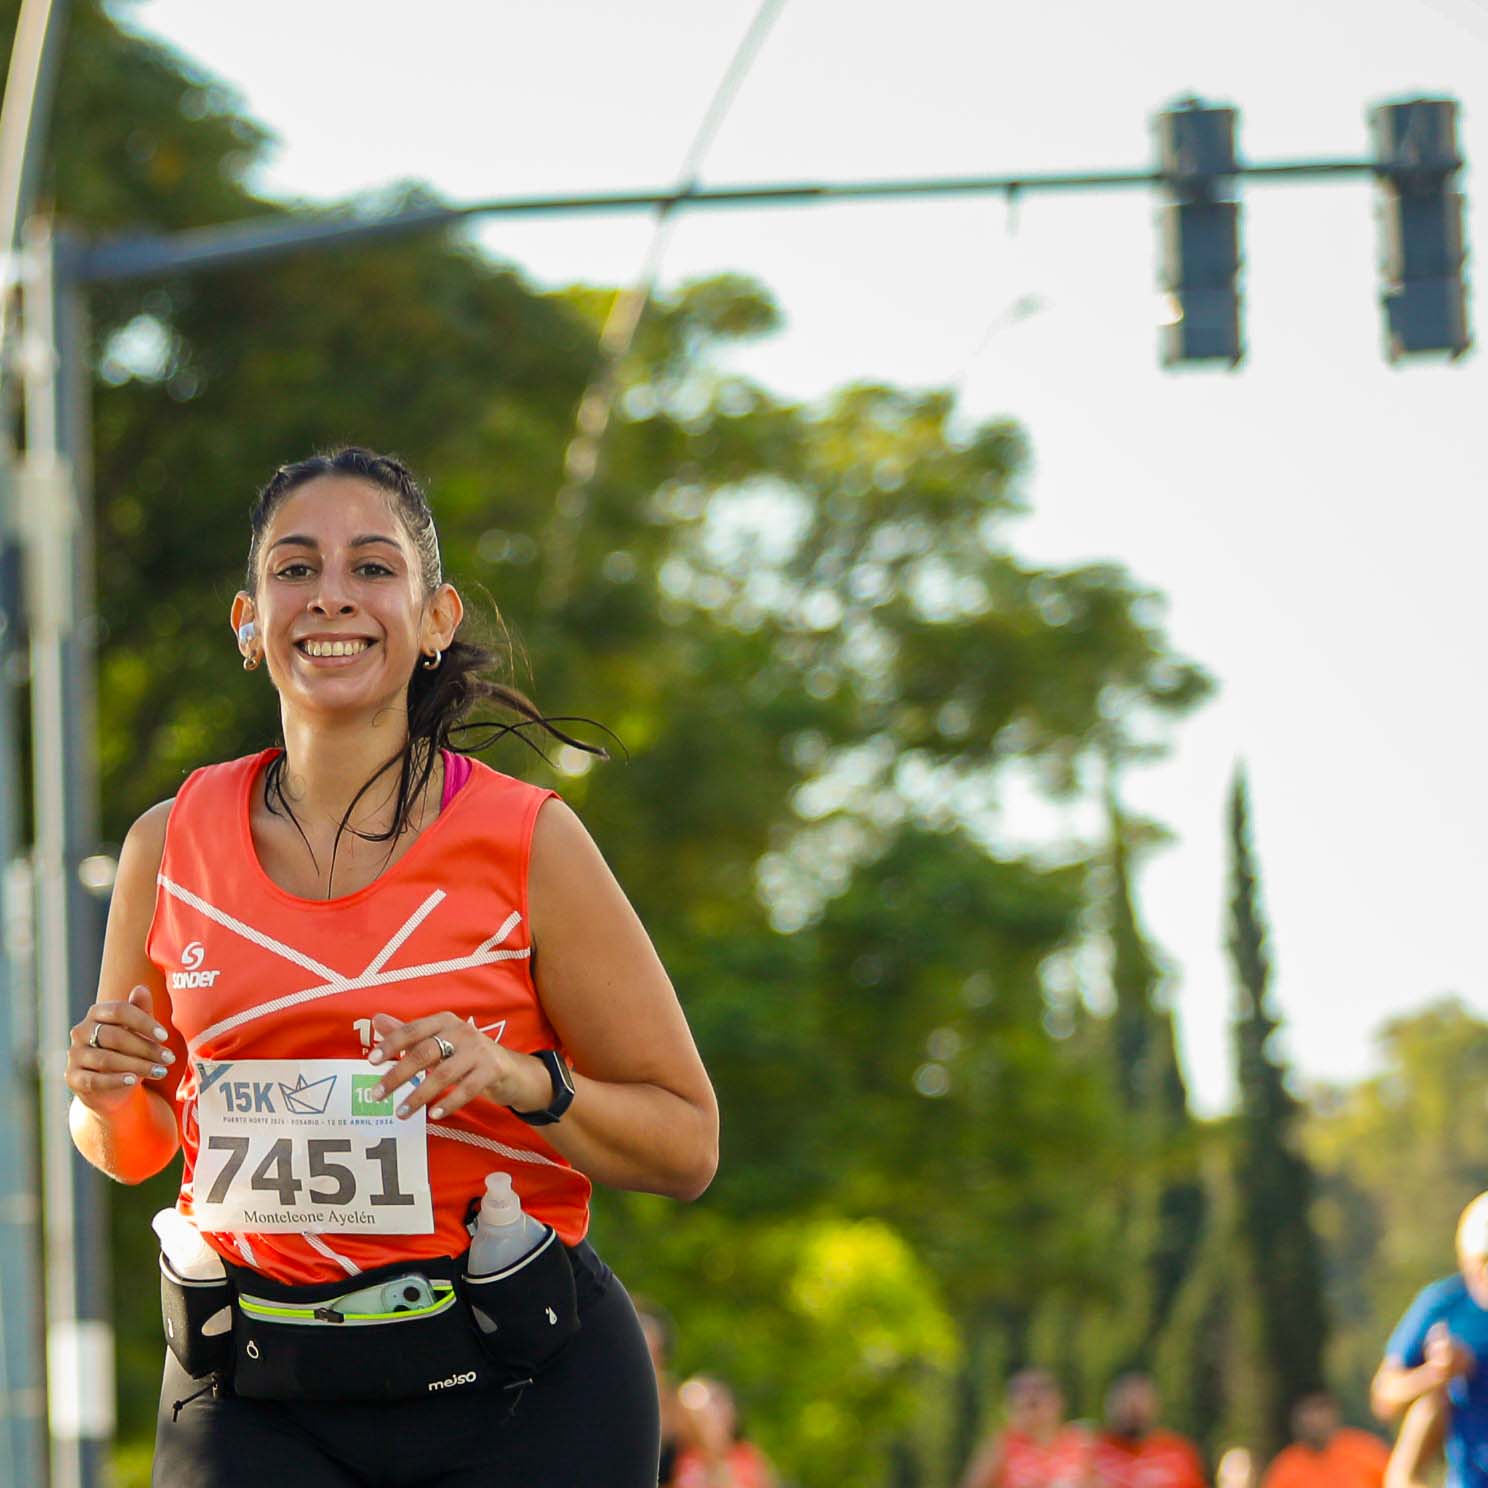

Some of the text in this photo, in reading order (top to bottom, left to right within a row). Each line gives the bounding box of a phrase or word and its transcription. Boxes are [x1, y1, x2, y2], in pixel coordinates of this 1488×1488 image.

[219, 1082, 276, 1113] 15K
[206, 1136, 416, 1206] 7451
[244, 1209, 377, 1226] Monteleone Ayelén
